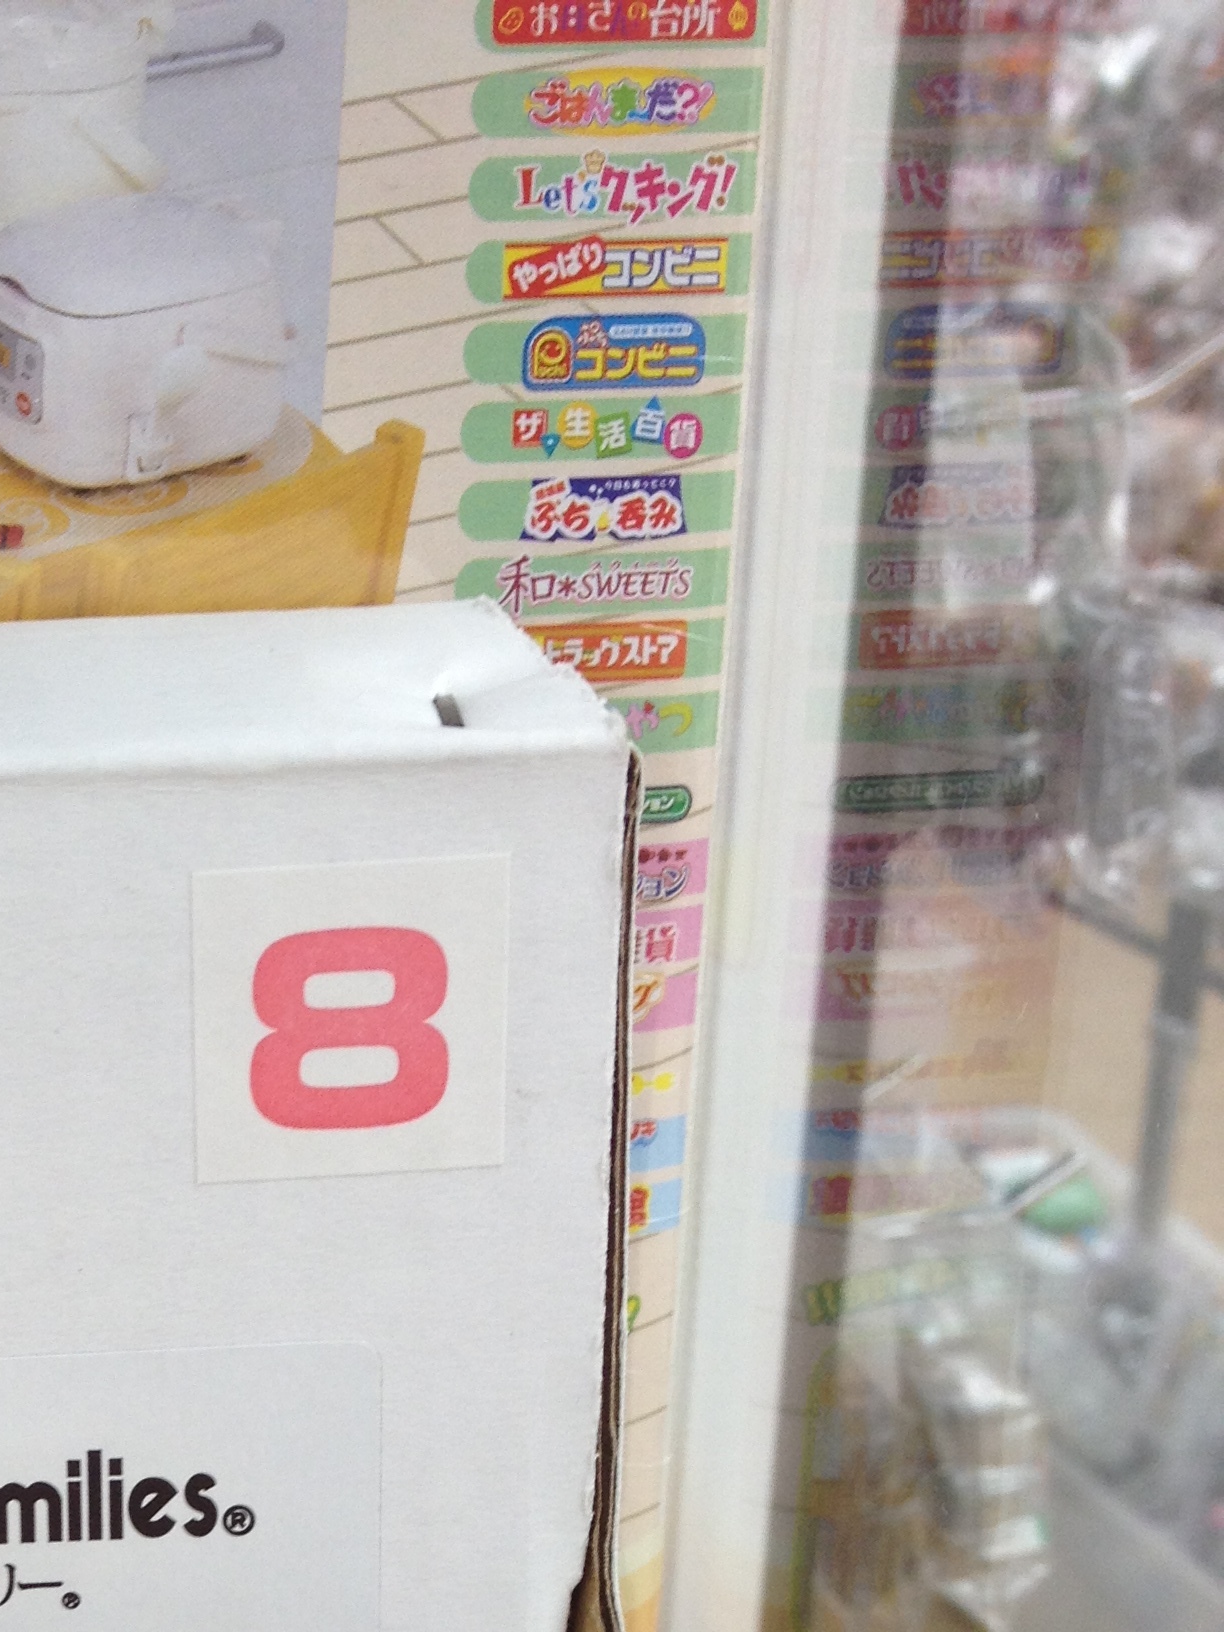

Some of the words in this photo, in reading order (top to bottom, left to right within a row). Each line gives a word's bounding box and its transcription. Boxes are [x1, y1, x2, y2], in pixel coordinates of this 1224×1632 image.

[603, 246, 721, 290] コンビニ
[575, 342, 698, 381] コンビニ
[249, 925, 449, 1131] 8
